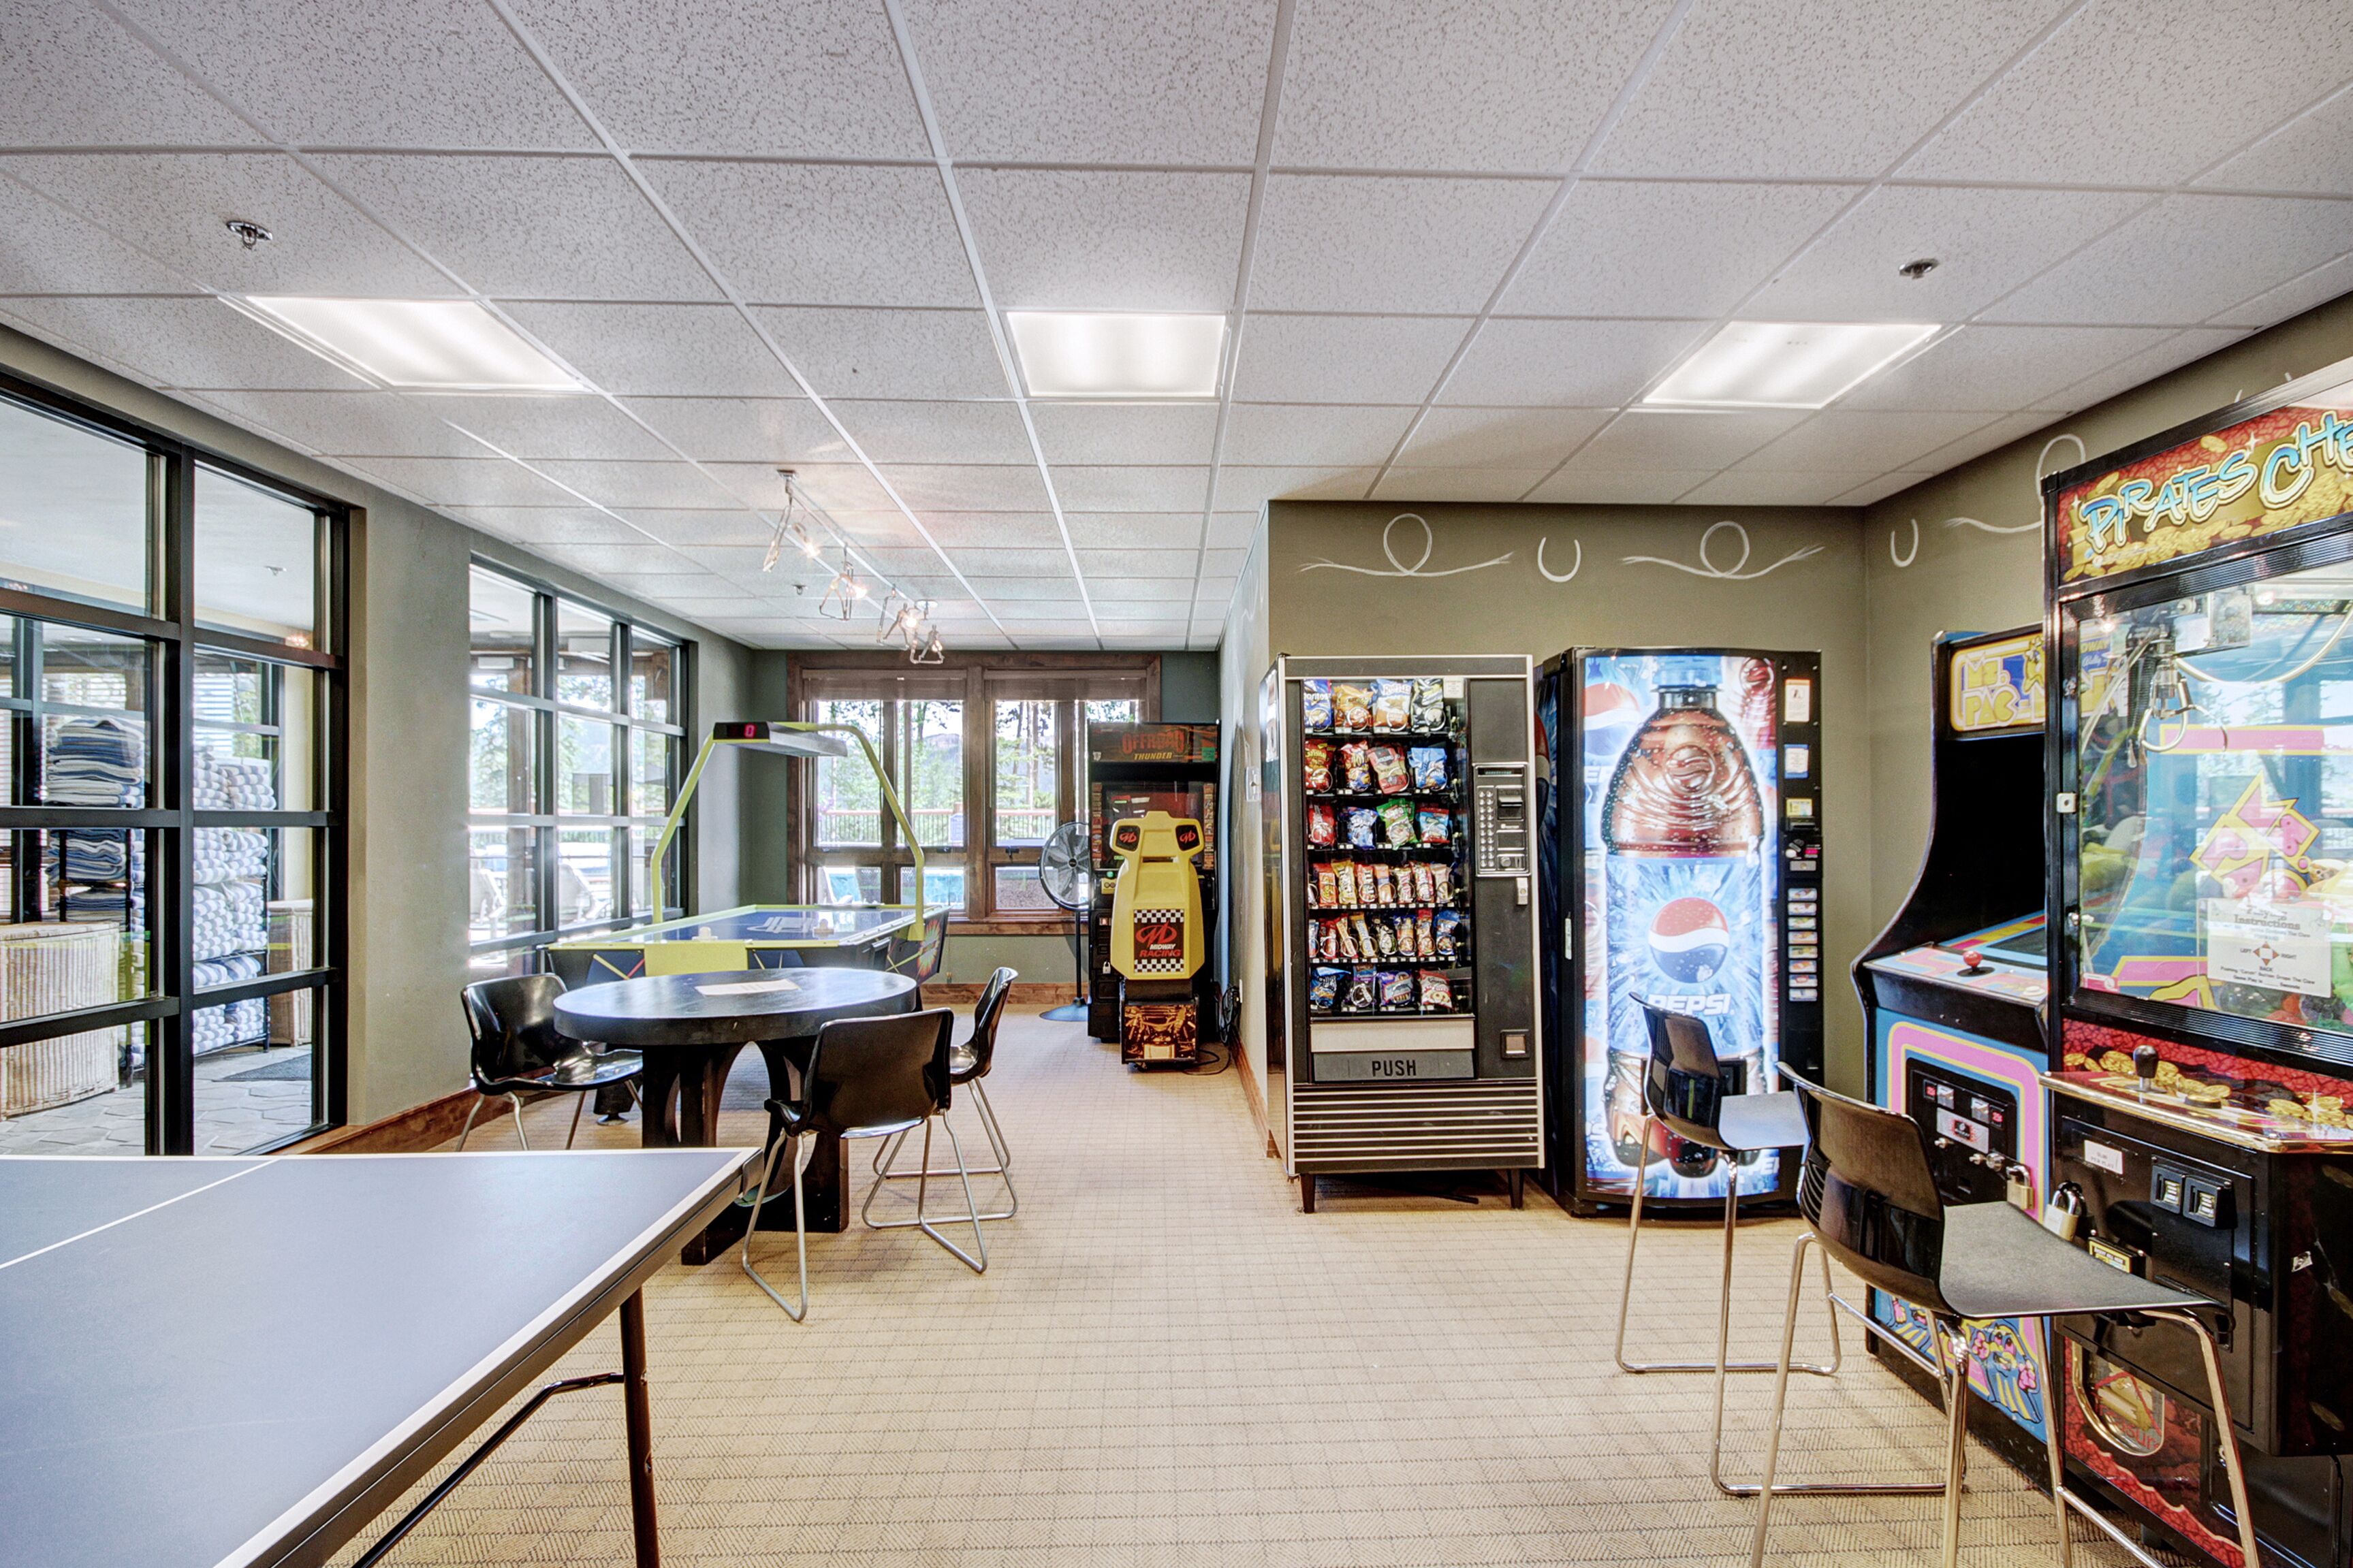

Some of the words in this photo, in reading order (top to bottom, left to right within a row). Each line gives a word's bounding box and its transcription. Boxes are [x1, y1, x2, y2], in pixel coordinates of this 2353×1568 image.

[2081, 450, 2258, 554] PIRATES
[1134, 752, 1173, 761] THUNDER
[2234, 914, 2301, 930] Instructions
[1139, 949, 1182, 958] RACING
[1646, 993, 1731, 1016] PEPSI
[1372, 1059, 1417, 1077] PUSH
